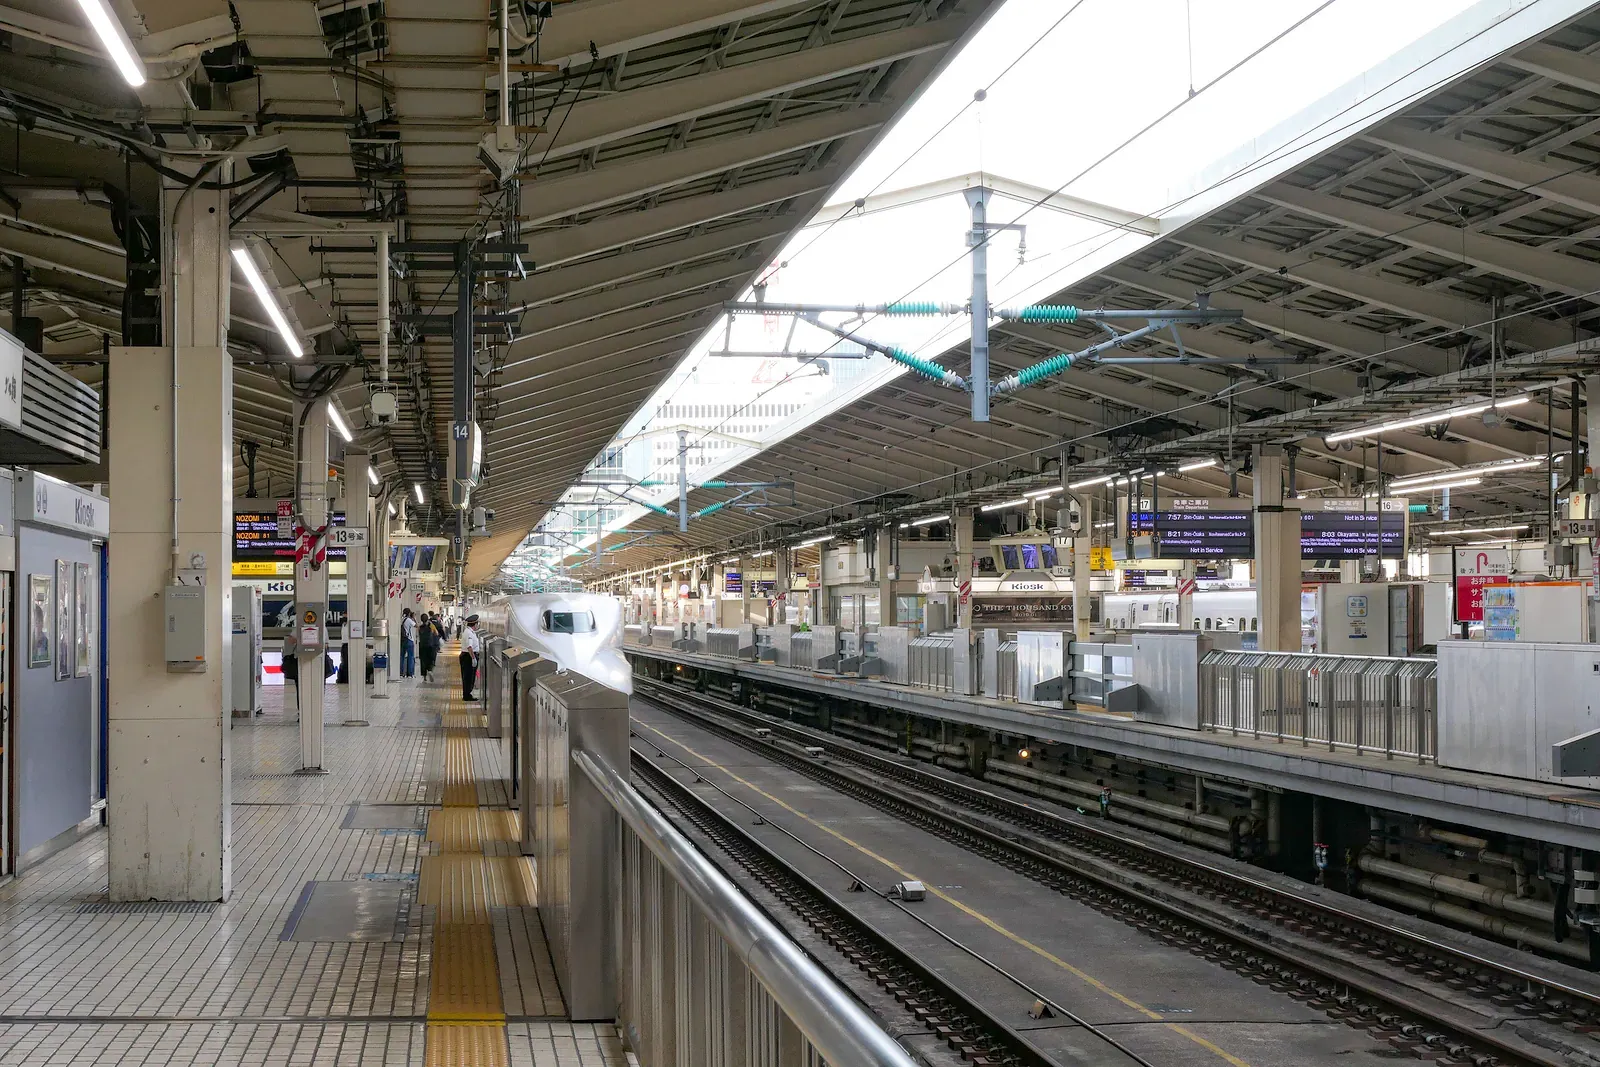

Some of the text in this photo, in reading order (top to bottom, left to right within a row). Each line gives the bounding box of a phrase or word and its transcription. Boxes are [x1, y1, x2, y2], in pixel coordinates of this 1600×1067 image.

[454, 425, 468, 438] 14
[1140, 500, 1149, 509] 17
[1382, 501, 1391, 510] 16
[74, 497, 95, 527] Kiosk
[1470, 577, 1494, 585] お弁当
